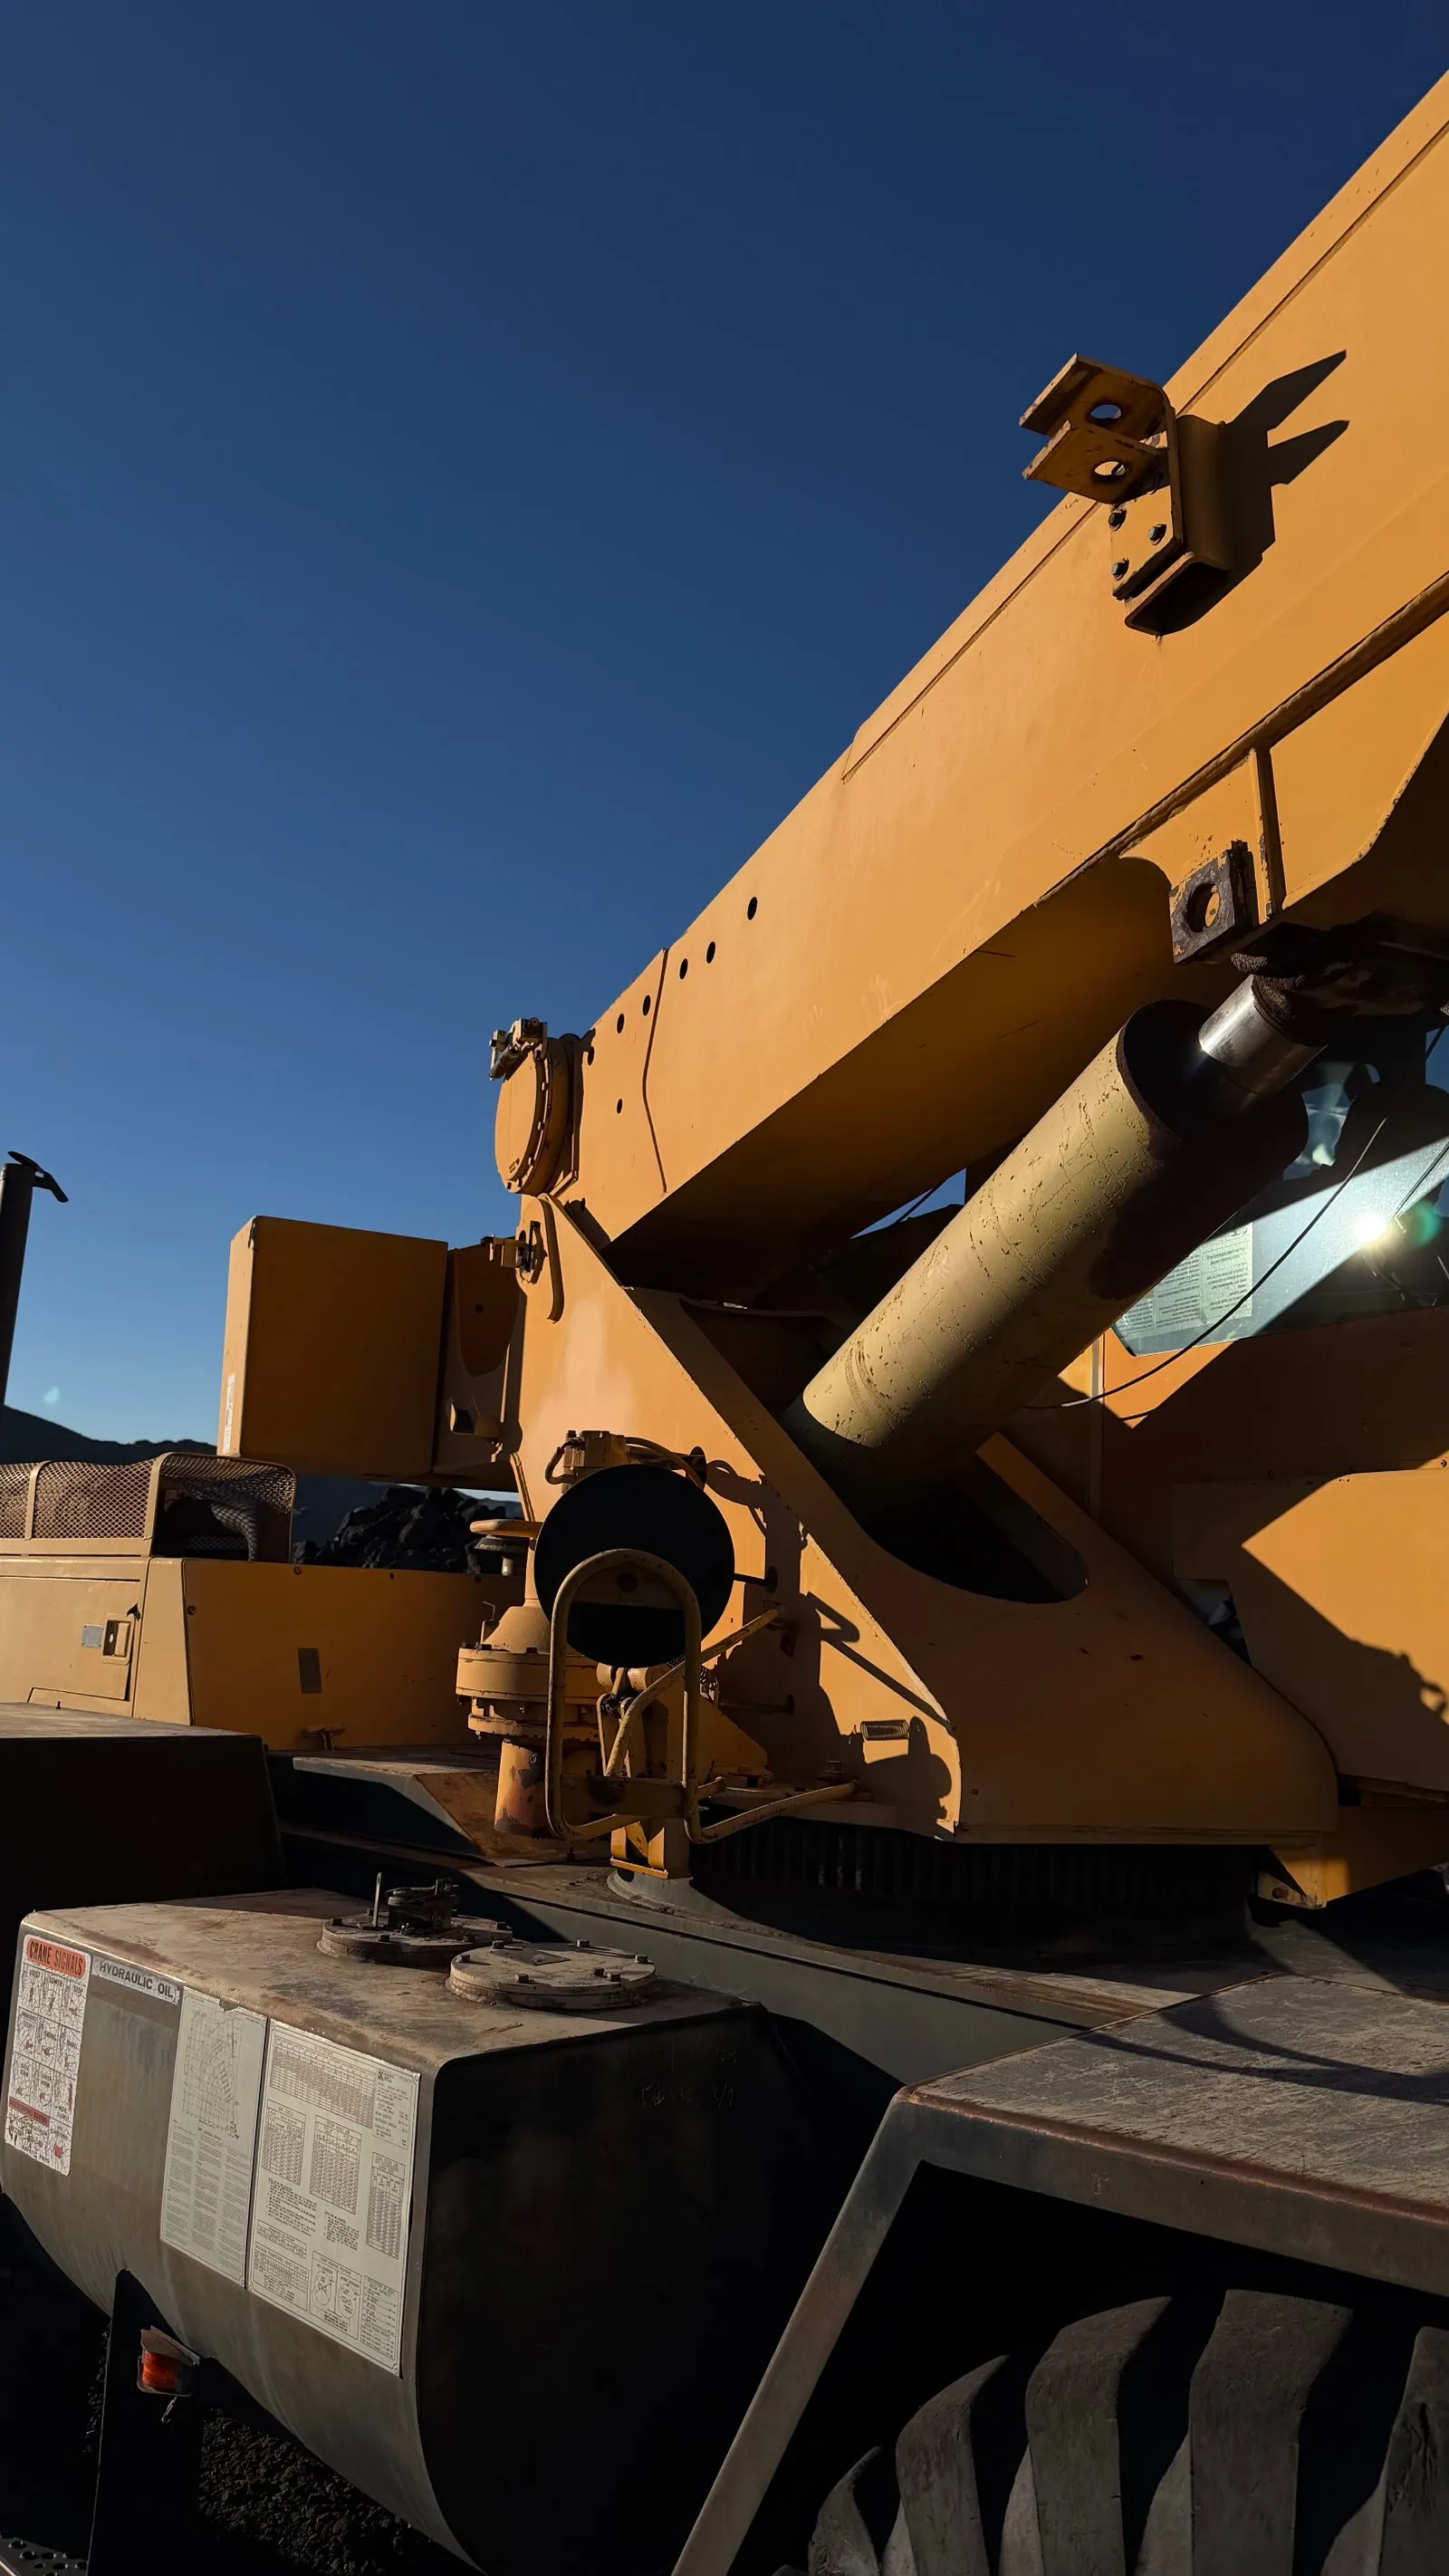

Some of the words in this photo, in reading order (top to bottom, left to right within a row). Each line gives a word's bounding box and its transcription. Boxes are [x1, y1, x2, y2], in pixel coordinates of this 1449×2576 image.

[30, 1940, 53, 1965] CRANE
[54, 1950, 83, 1975] SIGNALS
[100, 1960, 153, 1990] HYDRAULIC
[158, 1983, 174, 1998] OIL
